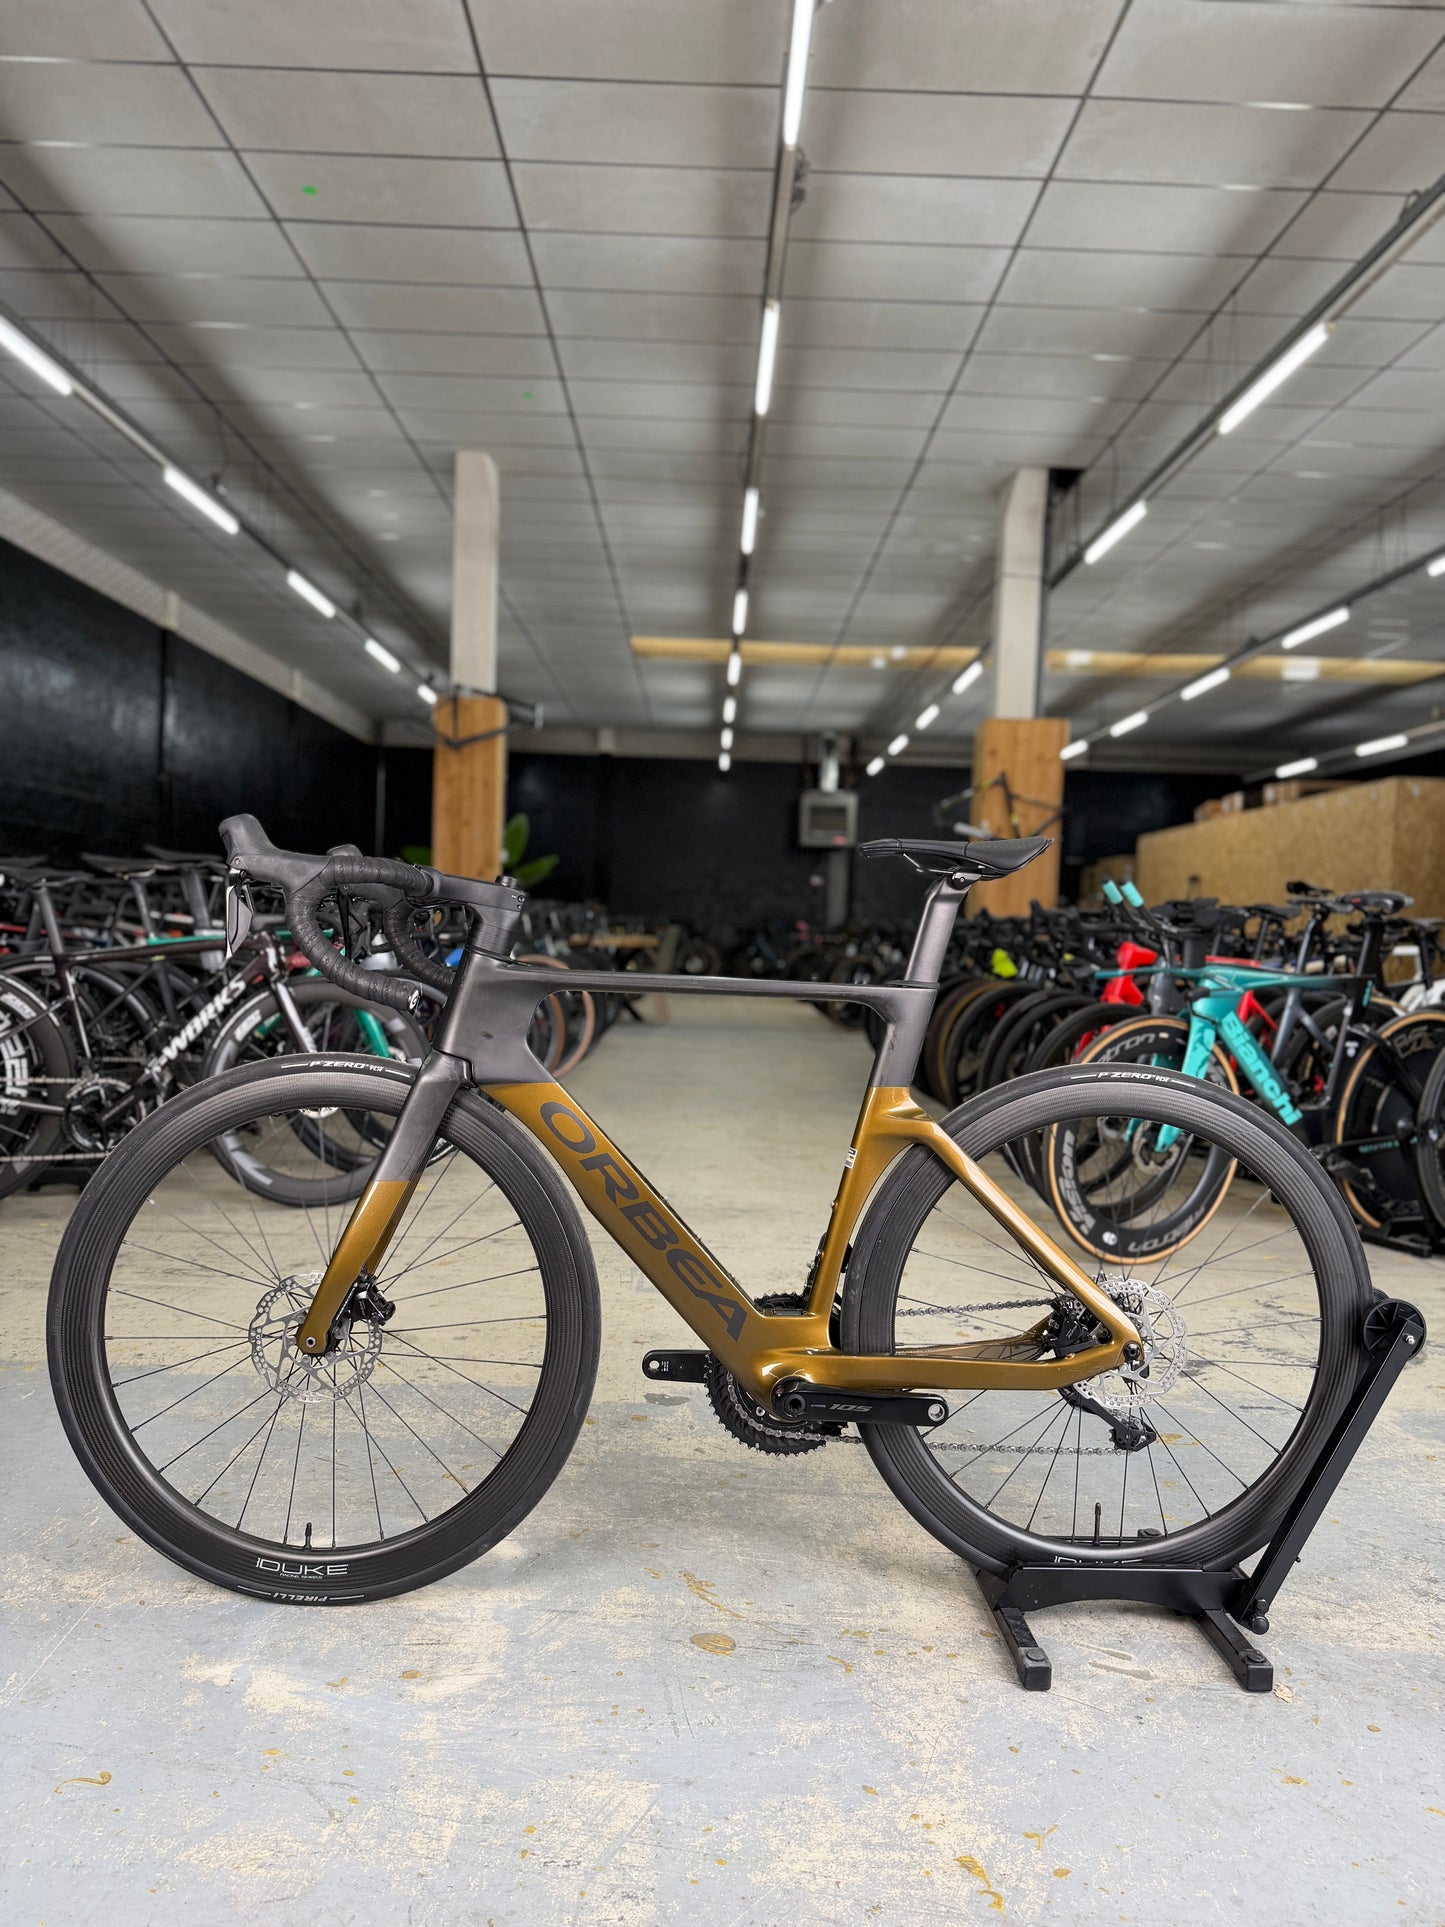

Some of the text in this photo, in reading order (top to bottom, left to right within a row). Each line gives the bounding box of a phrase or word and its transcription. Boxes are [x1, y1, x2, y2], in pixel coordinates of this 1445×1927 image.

[1222, 1011, 1303, 1126] Bianchi
[540, 1101, 748, 1343] ORBEA
[828, 1403, 873, 1412] 105
[256, 1557, 348, 1576] DUKE
[273, 1592, 328, 1602] PIRELLI
